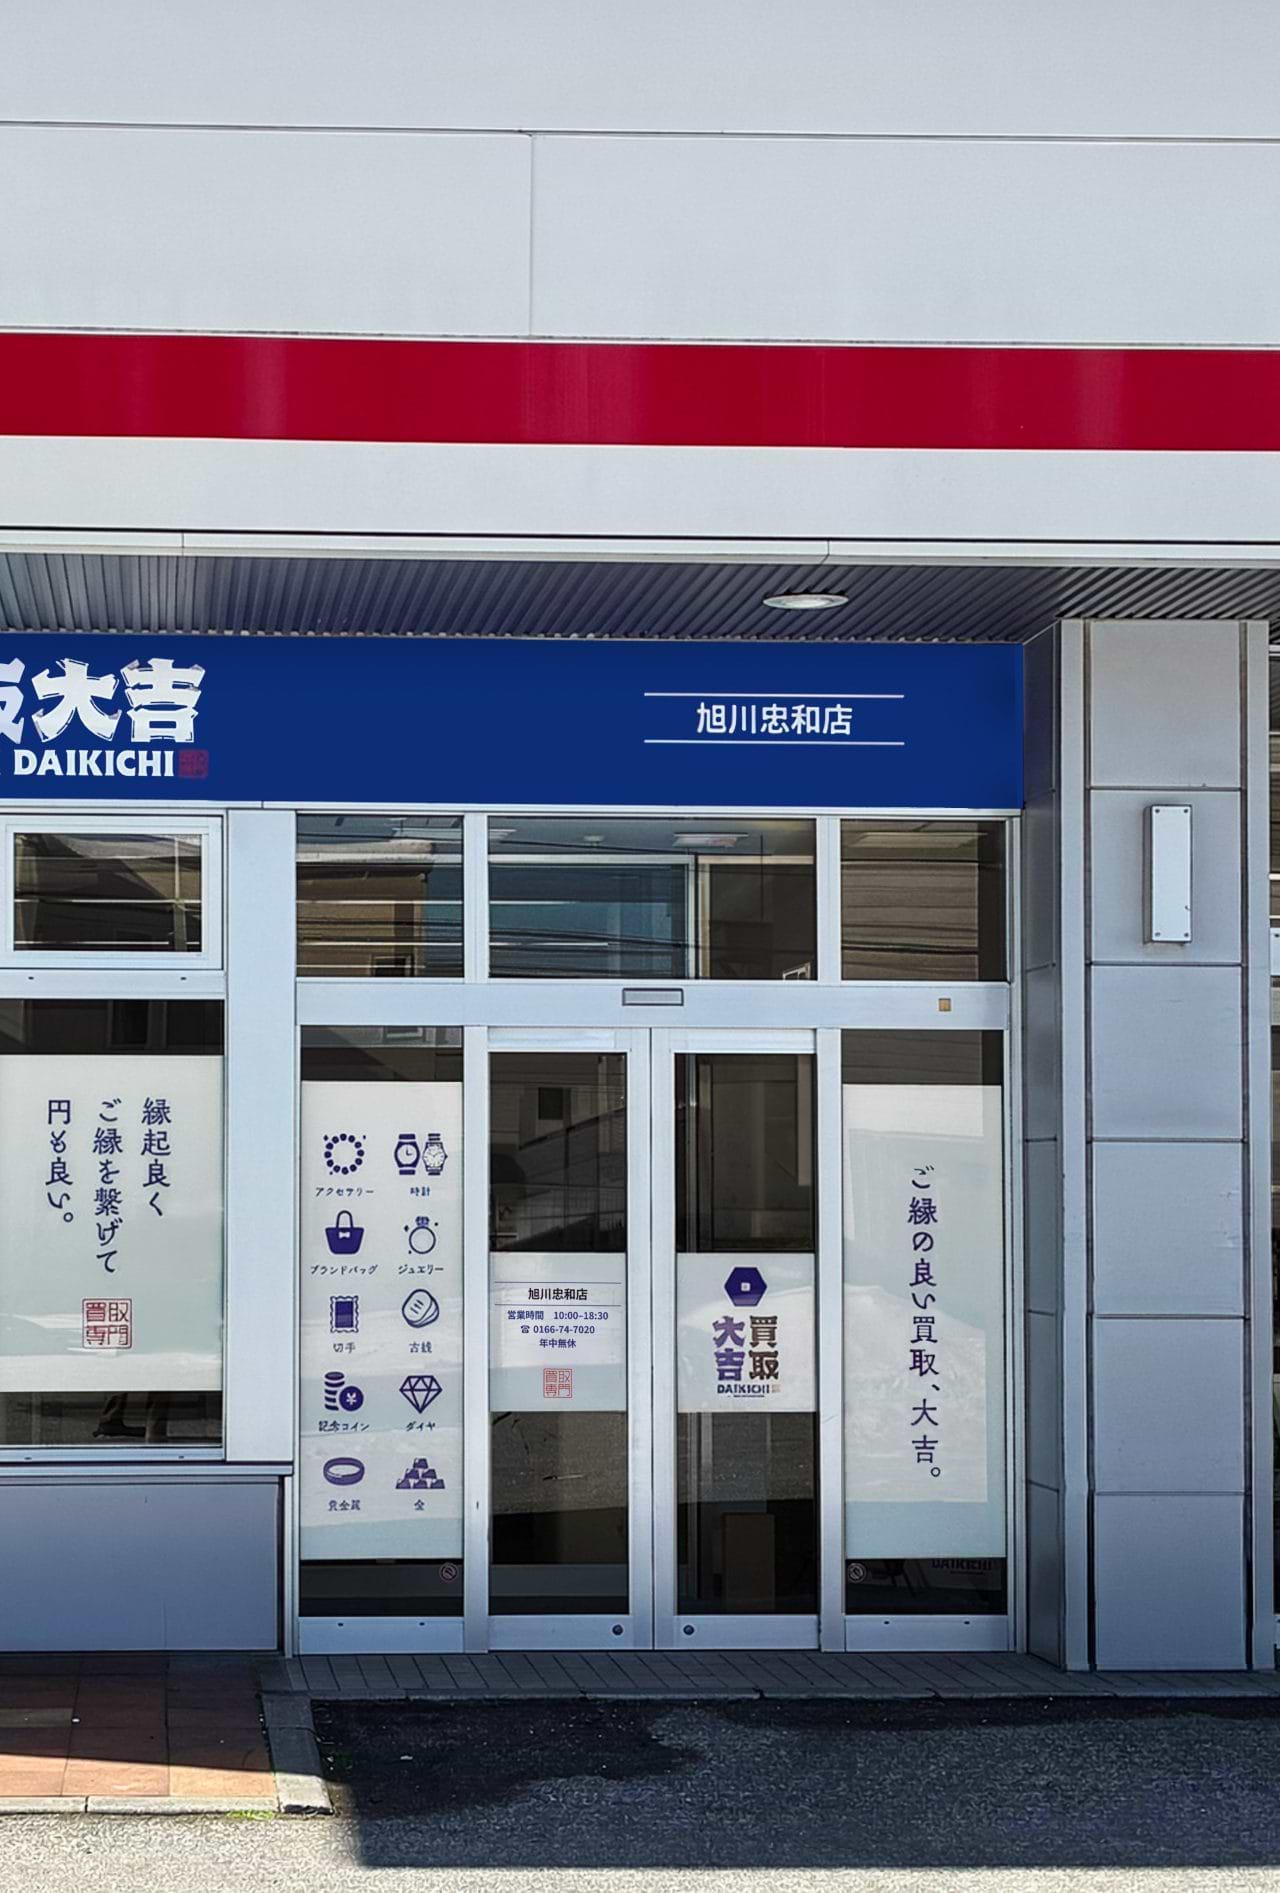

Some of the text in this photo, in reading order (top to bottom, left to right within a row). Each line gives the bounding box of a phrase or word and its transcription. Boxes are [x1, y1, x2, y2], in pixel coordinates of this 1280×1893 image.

[697, 702, 852, 735] 旭川忠和店
[13, 749, 175, 777] DAIKICHI
[44, 1099, 74, 1223] 円も良い。
[140, 1096, 172, 1217] 縁起良く
[92, 1097, 124, 1274] ご縁を繋げて
[397, 1263, 444, 1276] ジュエリー
[527, 1287, 588, 1301] 旭川忠和店
[507, 1309, 545, 1321] 営業時間
[532, 1324, 596, 1334] 0166-74-7020
[907, 1165, 941, 1478] ご縁の良い買取、大吉。
[539, 1337, 577, 1349] 年中無休
[712, 1315, 746, 1381] 大吉
[748, 1315, 779, 1381] 買取
